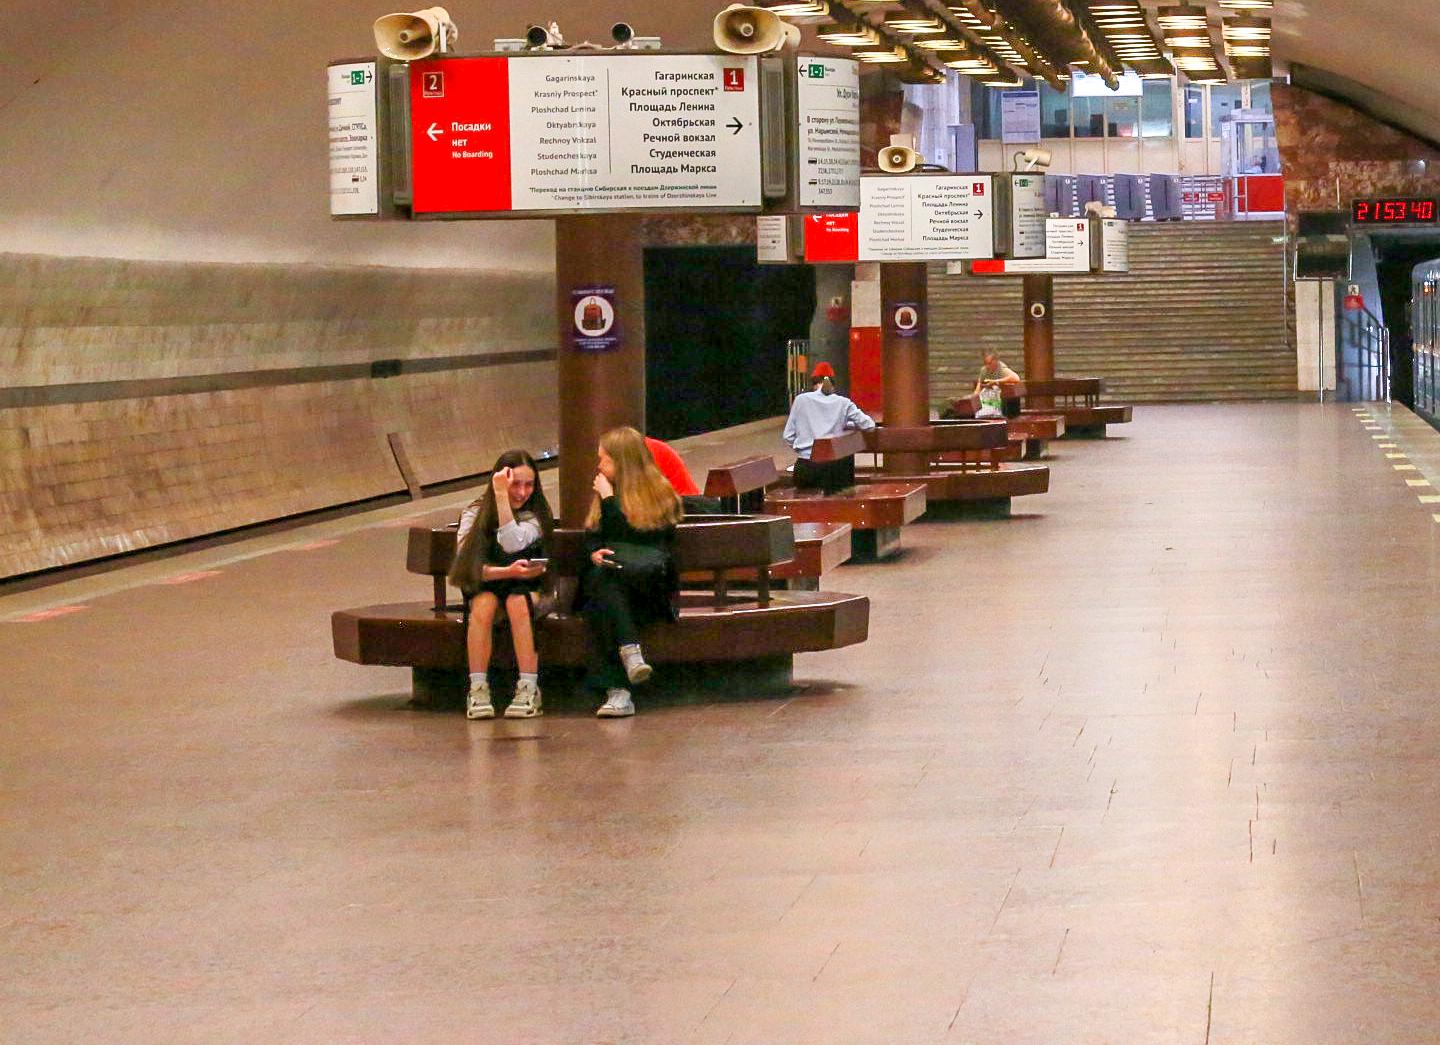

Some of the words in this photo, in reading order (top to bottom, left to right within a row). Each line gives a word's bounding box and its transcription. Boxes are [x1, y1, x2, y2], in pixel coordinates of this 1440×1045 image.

[546, 75, 595, 83] Gagarinskaya
[655, 71, 714, 82] Гагаринская
[730, 70, 738, 85] 1
[429, 75, 438, 90] 2
[622, 87, 667, 98] Красный
[630, 102, 676, 112] Площадь
[679, 102, 715, 111] Ленина
[452, 122, 492, 132] Посадки
[652, 118, 715, 128] Октябрьская
[643, 133, 680, 142] Речной
[462, 151, 493, 159] Boarding
[650, 149, 716, 160] Студенческая
[631, 165, 678, 174] Площадь
[681, 164, 717, 174] Маркса
